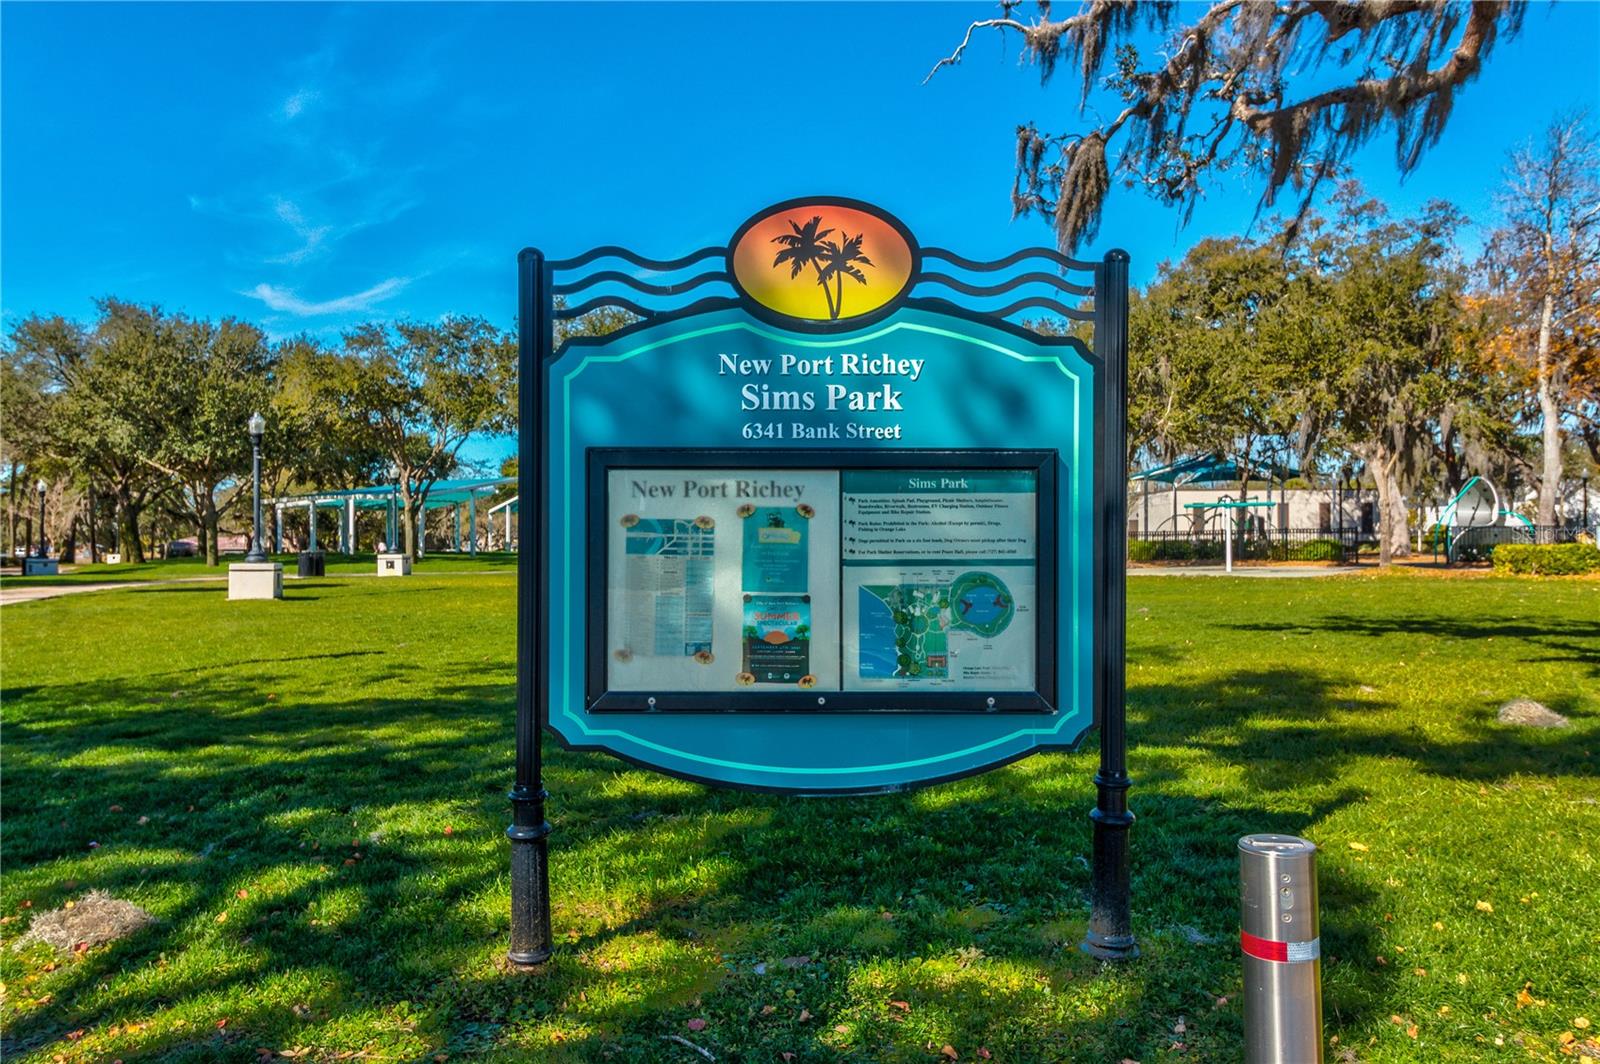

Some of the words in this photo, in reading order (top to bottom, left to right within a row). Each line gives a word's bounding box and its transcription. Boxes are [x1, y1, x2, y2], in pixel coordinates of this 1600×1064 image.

[718, 354, 772, 376] New
[780, 354, 834, 376] Port
[840, 353, 925, 381] Richey
[741, 383, 815, 412] Sims
[825, 383, 904, 412] Park
[742, 423, 784, 440] 6341
[791, 423, 840, 440] Bank
[846, 423, 902, 440] Street
[631, 480, 676, 498] New
[683, 480, 732, 498] Port
[735, 480, 806, 502] Richey
[908, 478, 936, 489] Sims
[941, 478, 968, 489] Park
[754, 612, 799, 620] SUMMER
